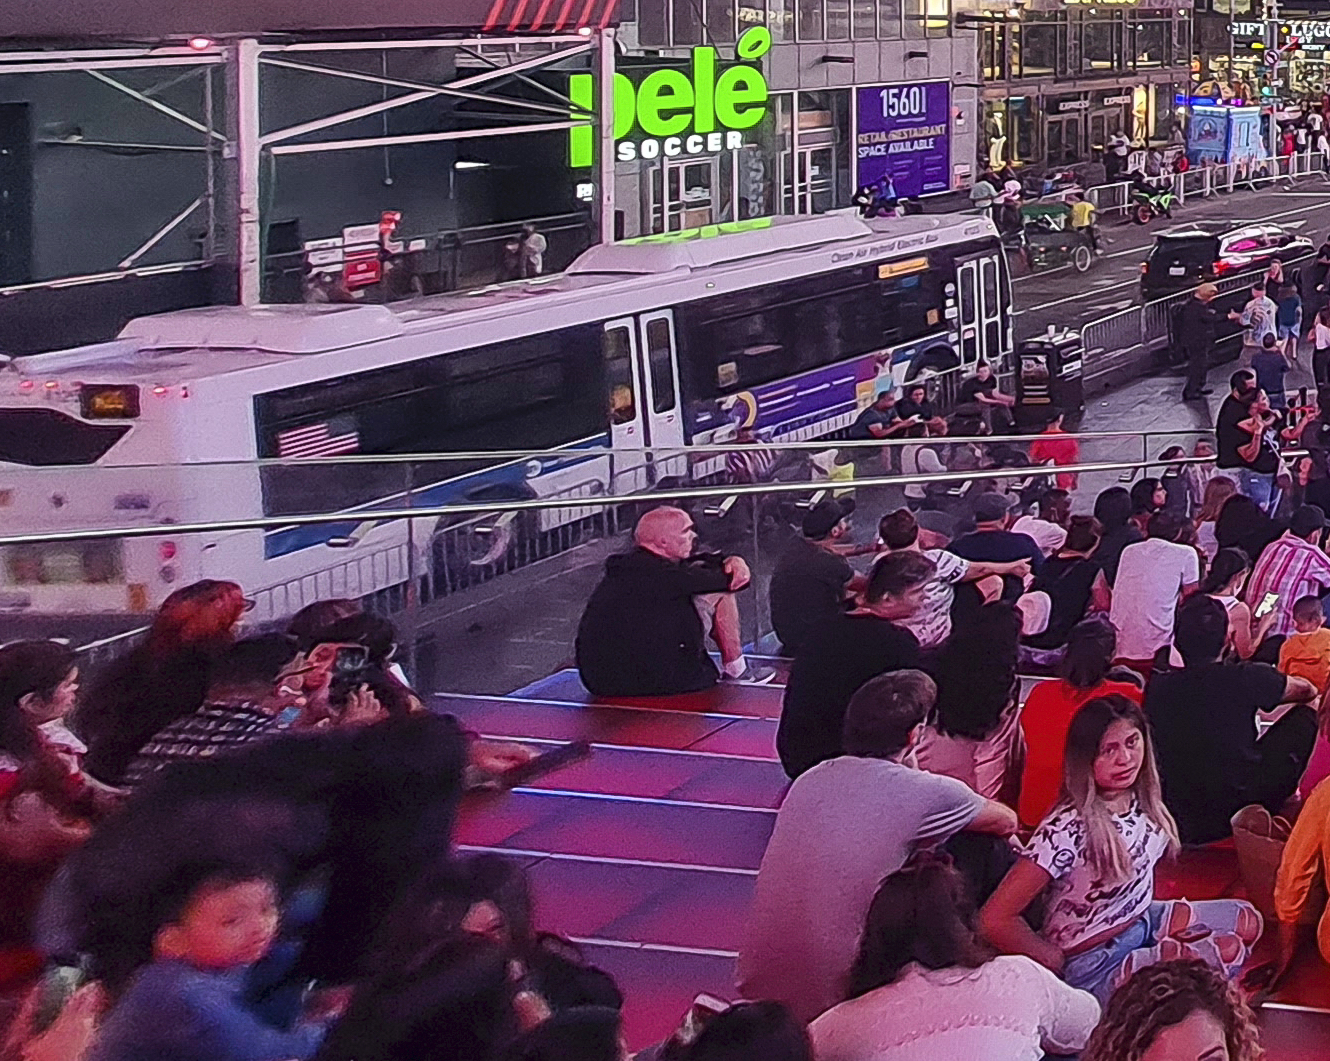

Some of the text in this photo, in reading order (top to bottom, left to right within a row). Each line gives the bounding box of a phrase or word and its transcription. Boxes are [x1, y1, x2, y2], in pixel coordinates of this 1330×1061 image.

[569, 25, 772, 168] pelé
[617, 130, 743, 161] SOCCER
[857, 138, 935, 158] SPACE AVAILABLE
